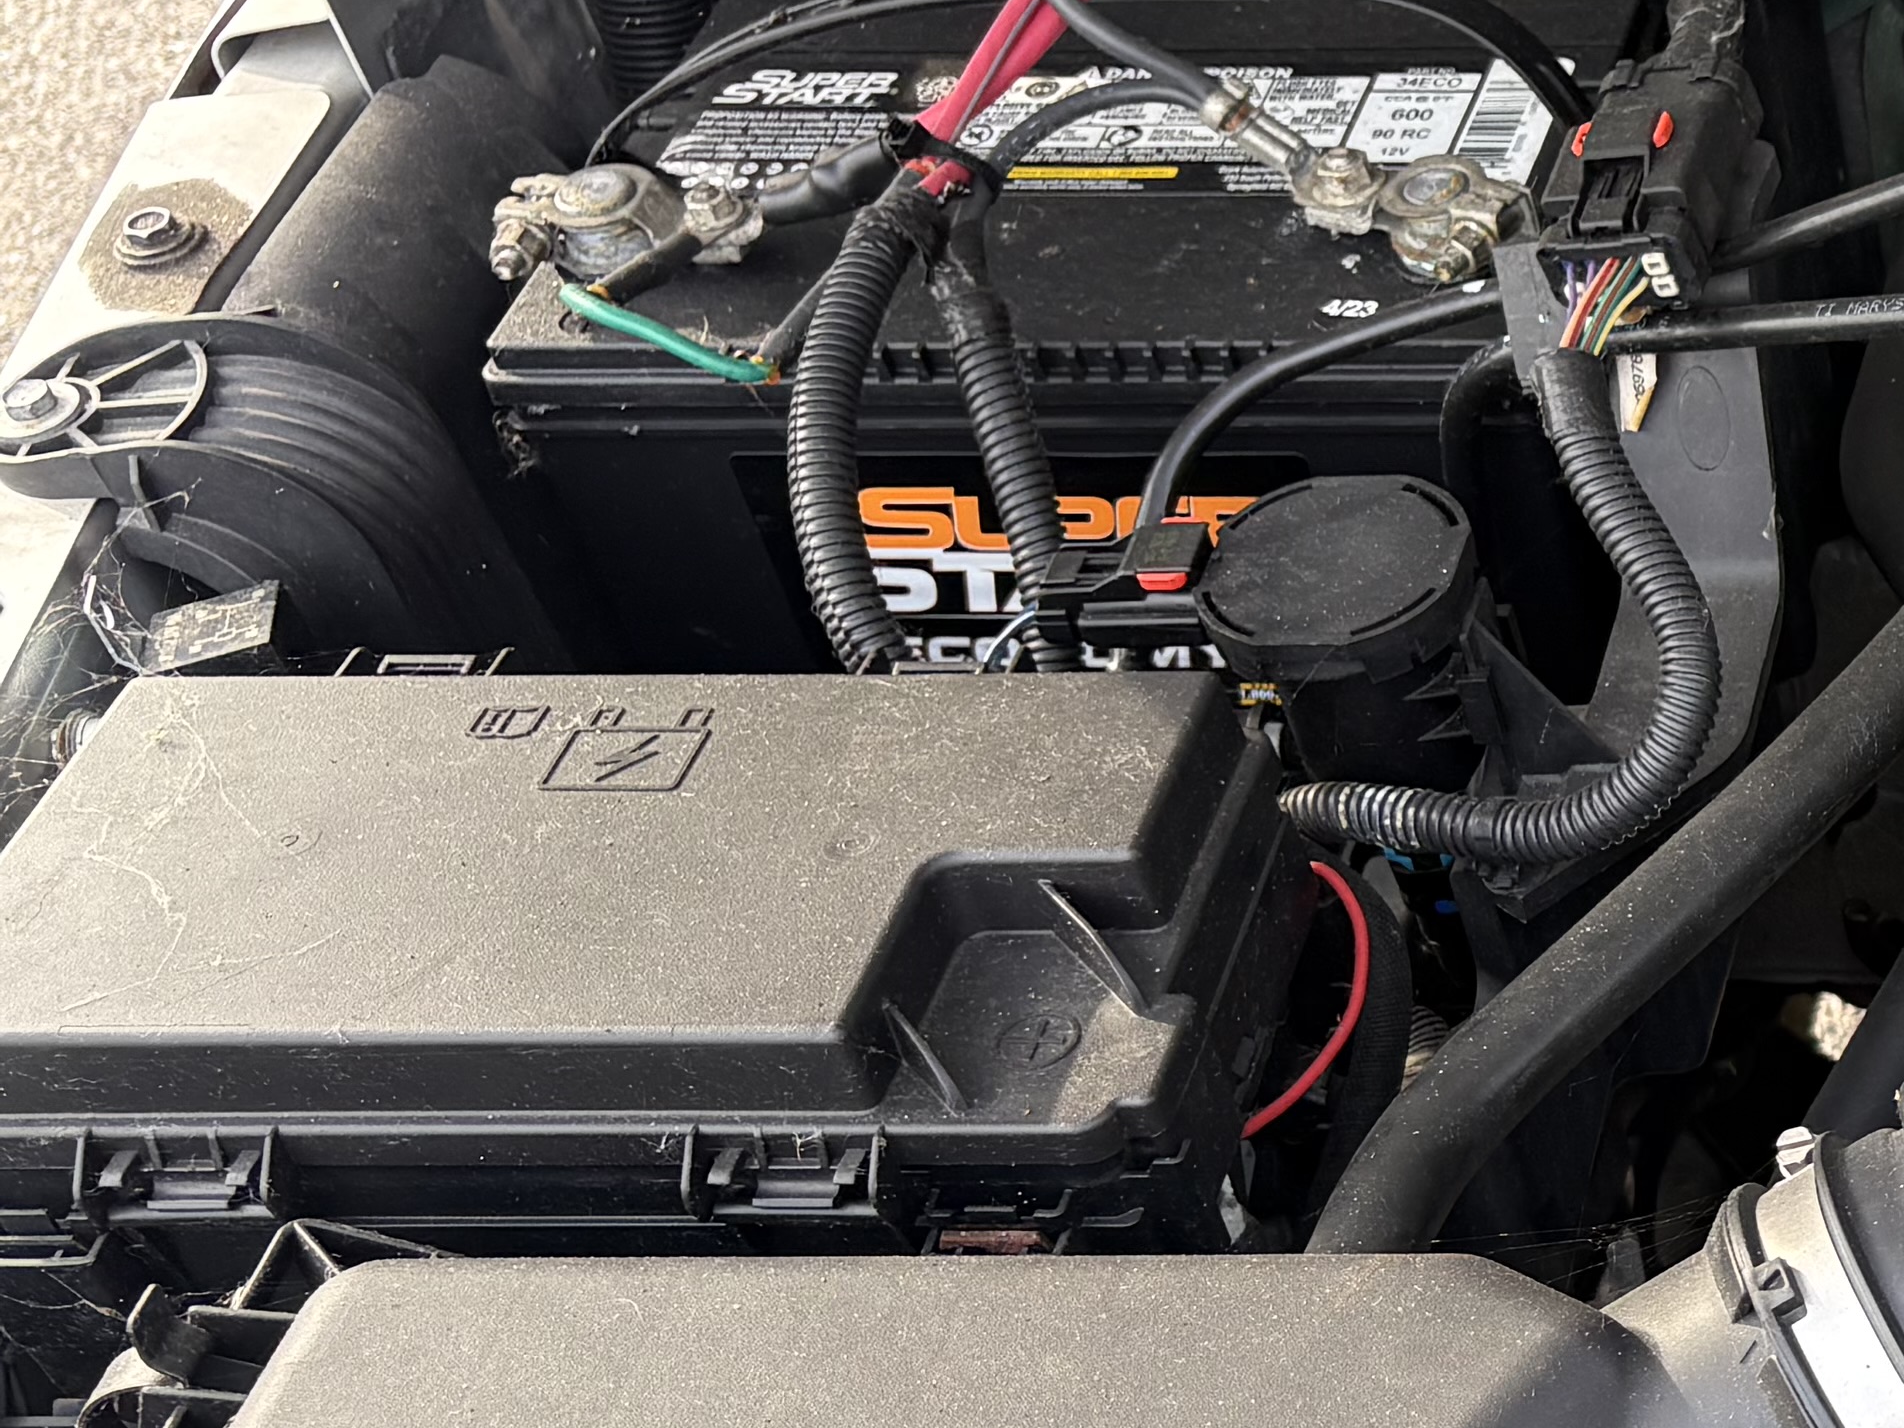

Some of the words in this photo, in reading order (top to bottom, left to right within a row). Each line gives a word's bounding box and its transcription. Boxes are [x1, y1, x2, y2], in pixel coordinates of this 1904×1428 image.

[745, 68, 899, 90] SUPER
[711, 82, 884, 106] START
[1390, 108, 1434, 122] 600
[1371, 128, 1397, 140] 90
[1320, 299, 1379, 318] 4/23
